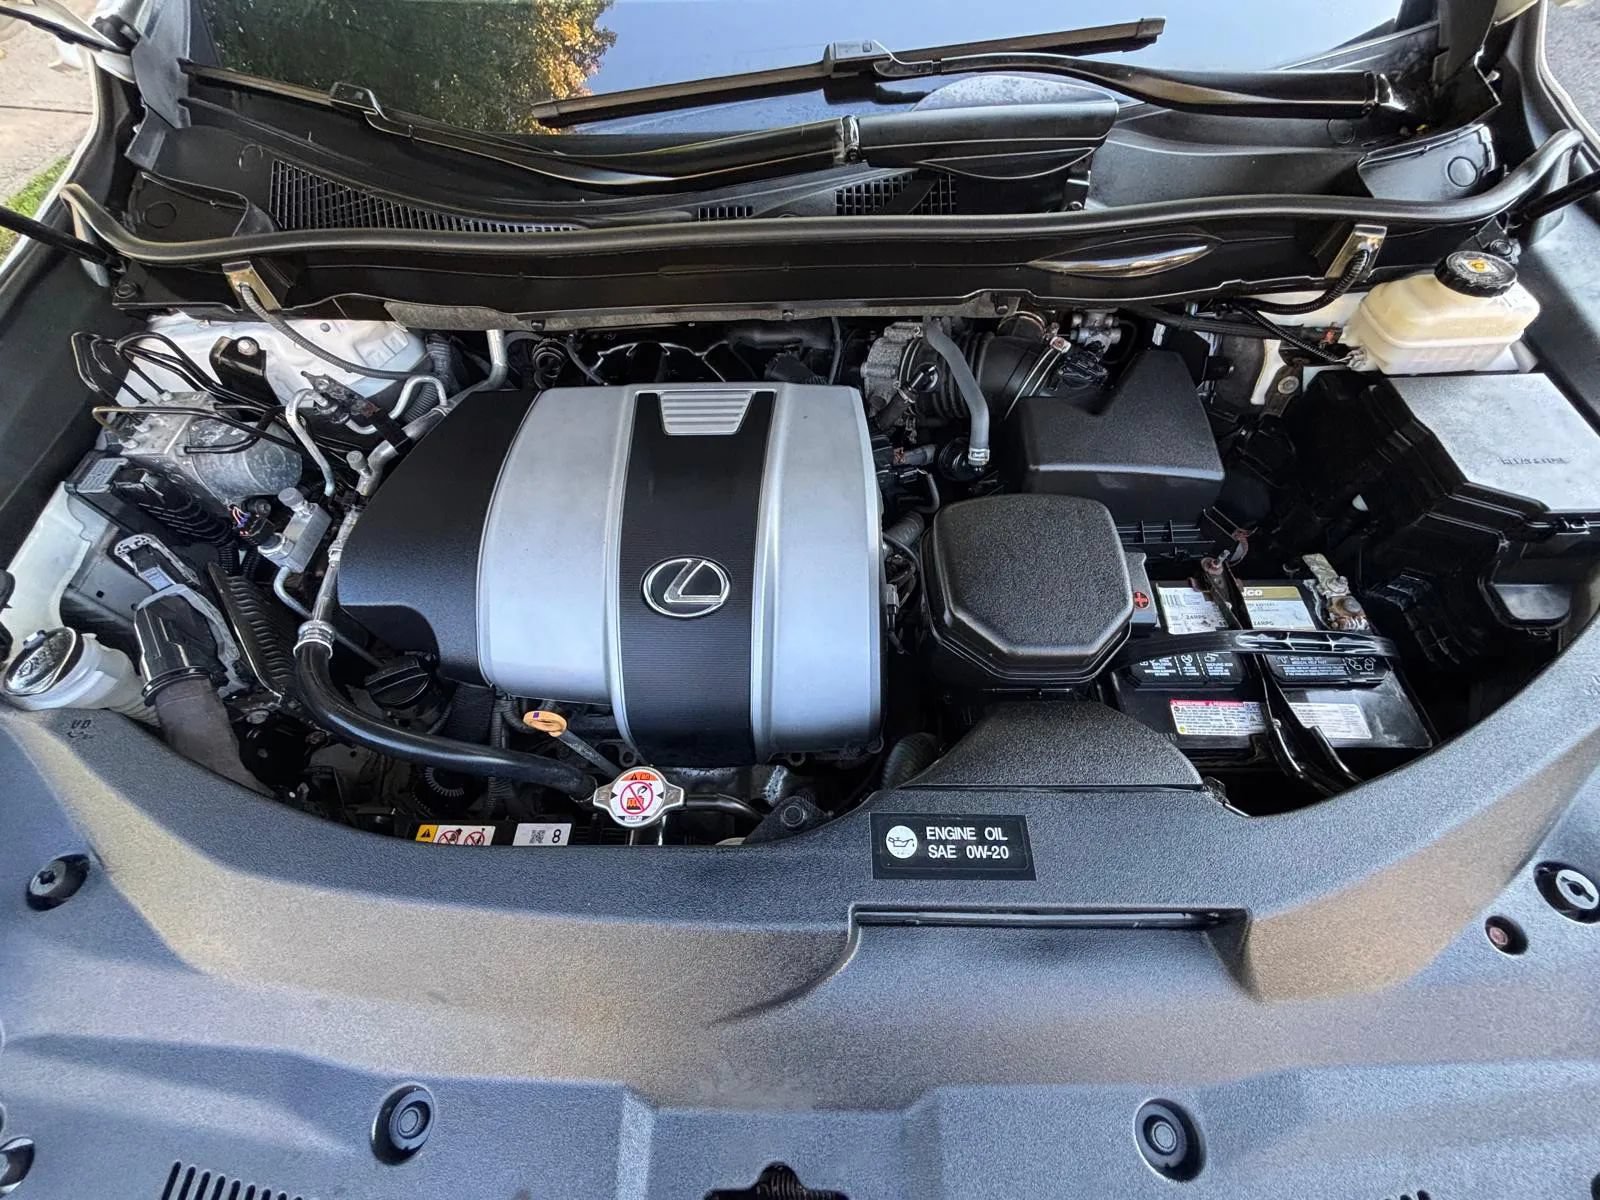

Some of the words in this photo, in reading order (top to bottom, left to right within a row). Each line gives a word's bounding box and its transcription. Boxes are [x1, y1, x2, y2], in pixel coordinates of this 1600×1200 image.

[551, 828, 562, 844] 8
[926, 826, 977, 840] ENGINE
[984, 827, 1008, 841] OIL
[928, 845, 957, 859] SAE
[966, 845, 1009, 859] 0W-20
